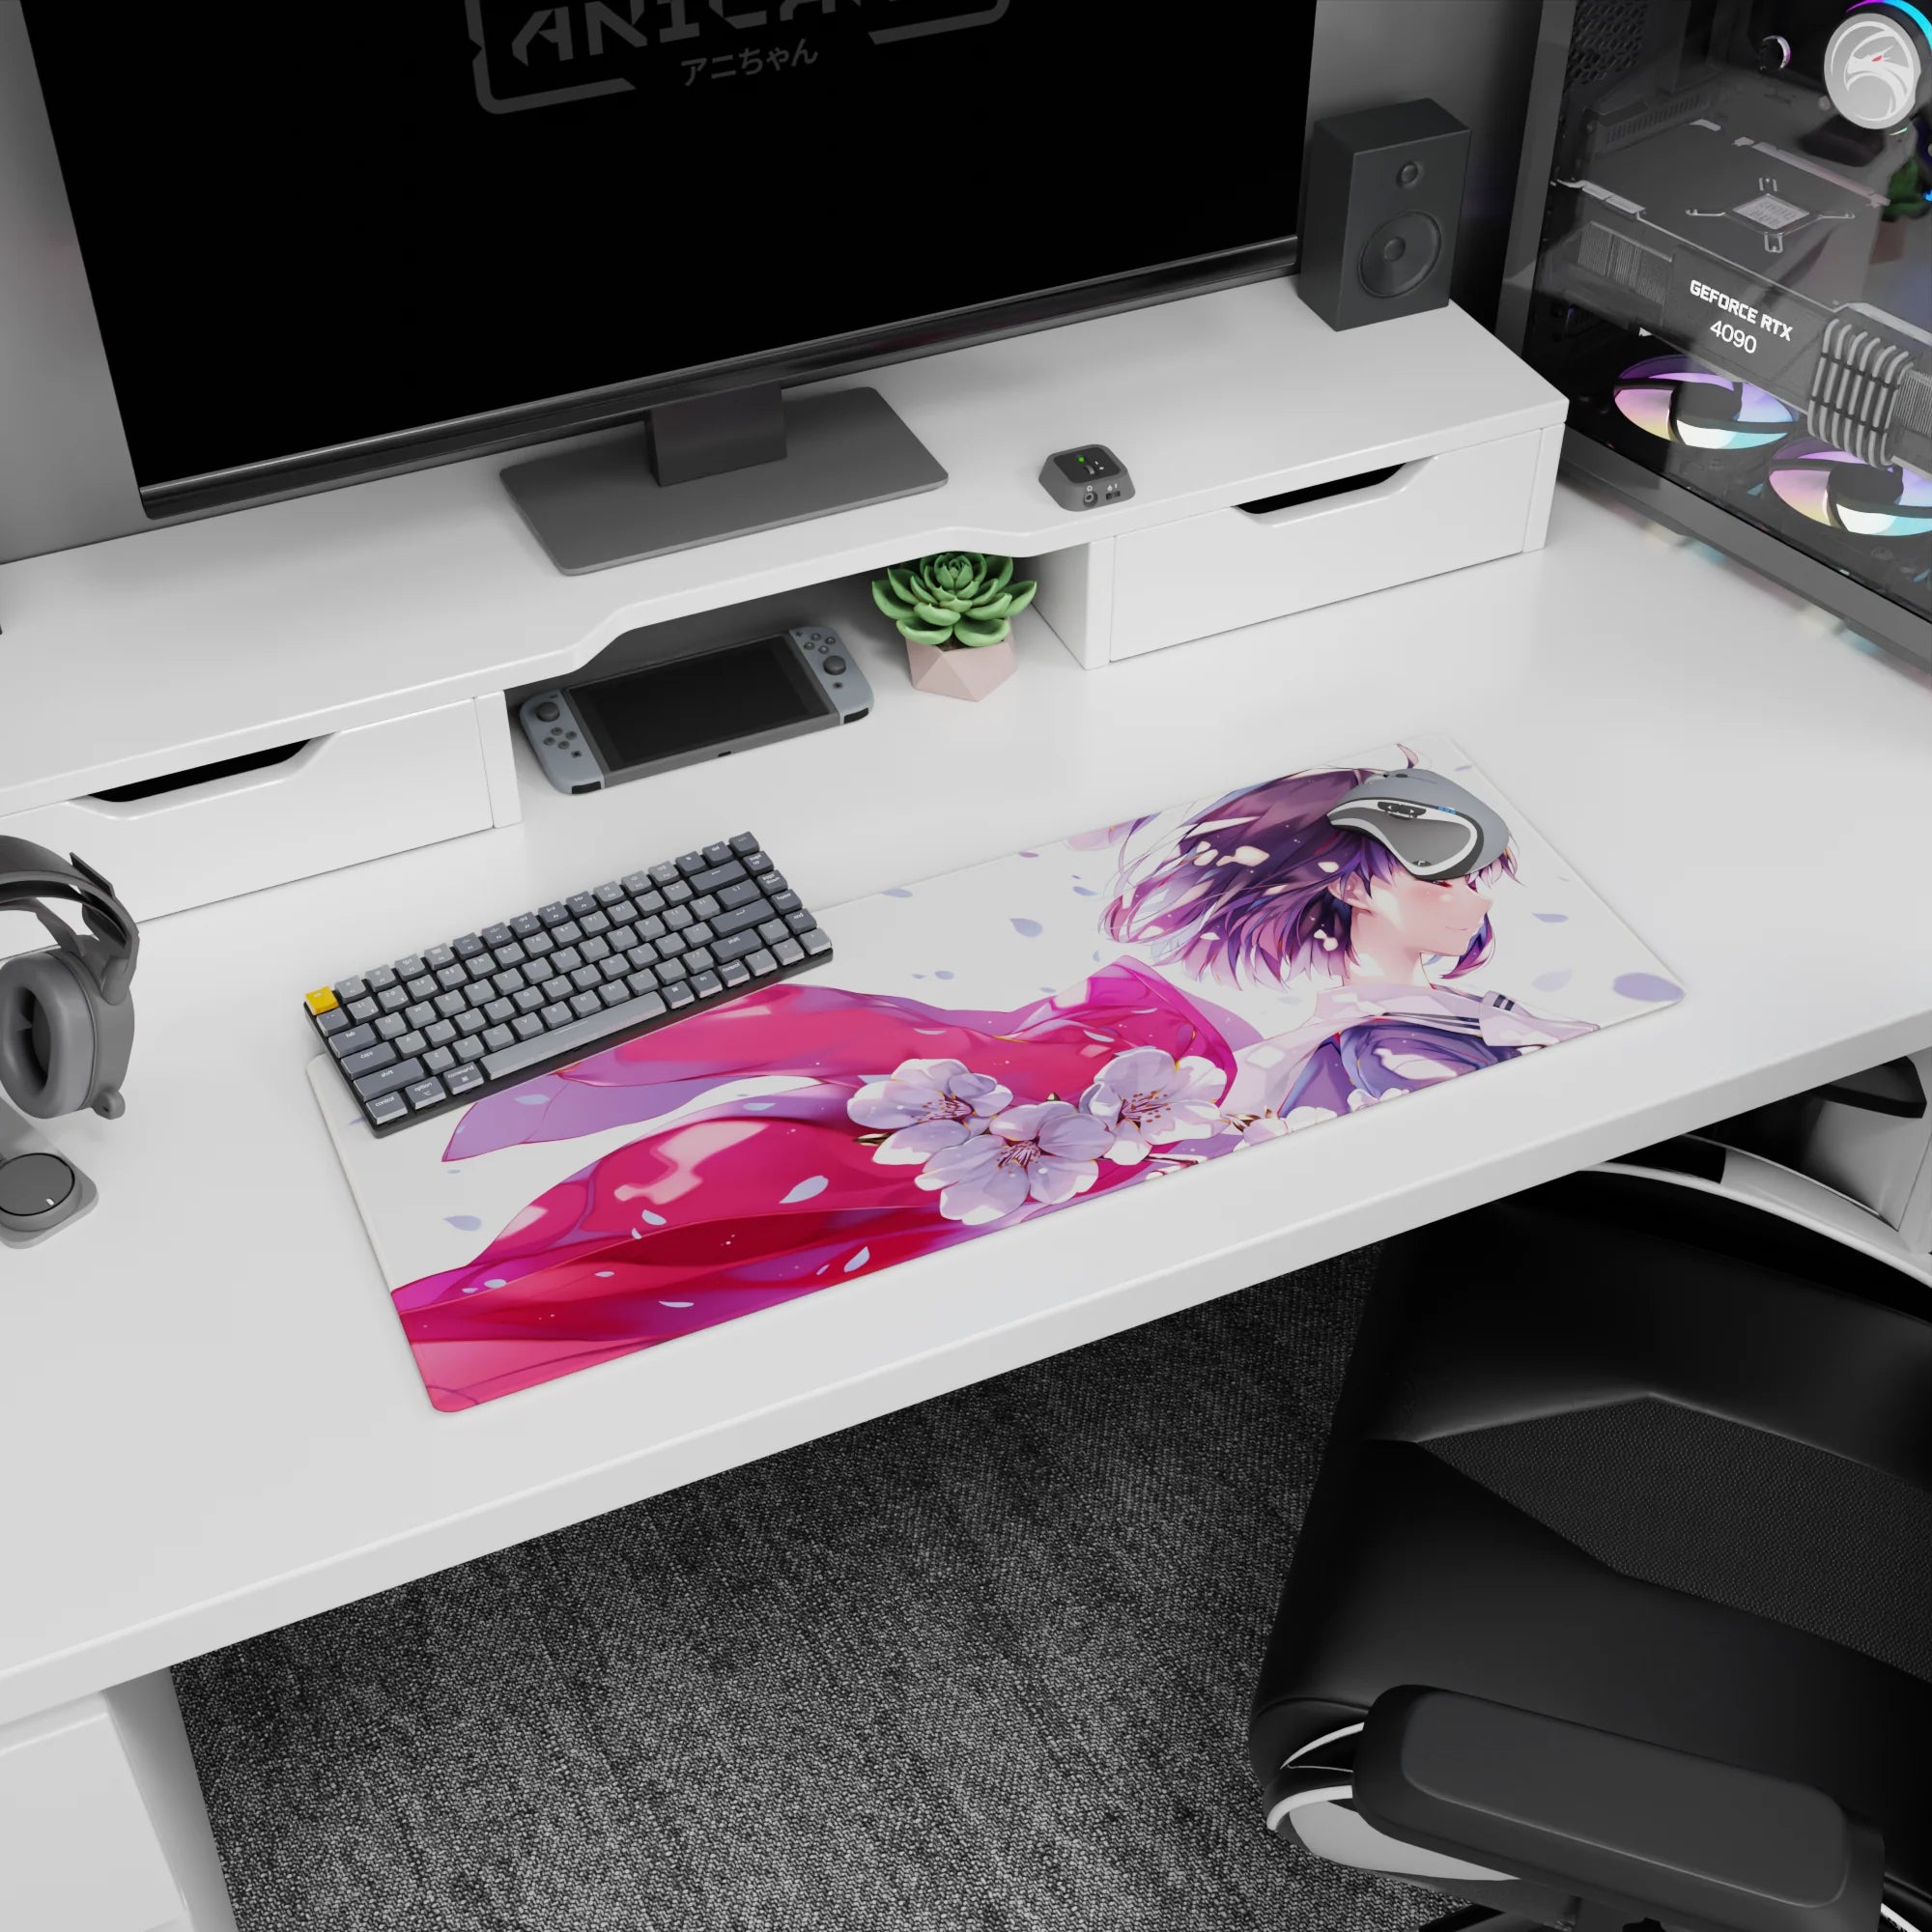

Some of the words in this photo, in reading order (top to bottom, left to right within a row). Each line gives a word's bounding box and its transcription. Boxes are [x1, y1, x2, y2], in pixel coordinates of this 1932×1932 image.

[680, 38, 819, 87] アニちゃん
[1690, 279, 1758, 324] GEFORCE
[1760, 313, 1794, 342] RTX
[1710, 320, 1757, 354] 4090
[381, 1069, 394, 1078] shift
[447, 1065, 474, 1078] command
[413, 1082, 433, 1093] option
[375, 1095, 395, 1107] control
